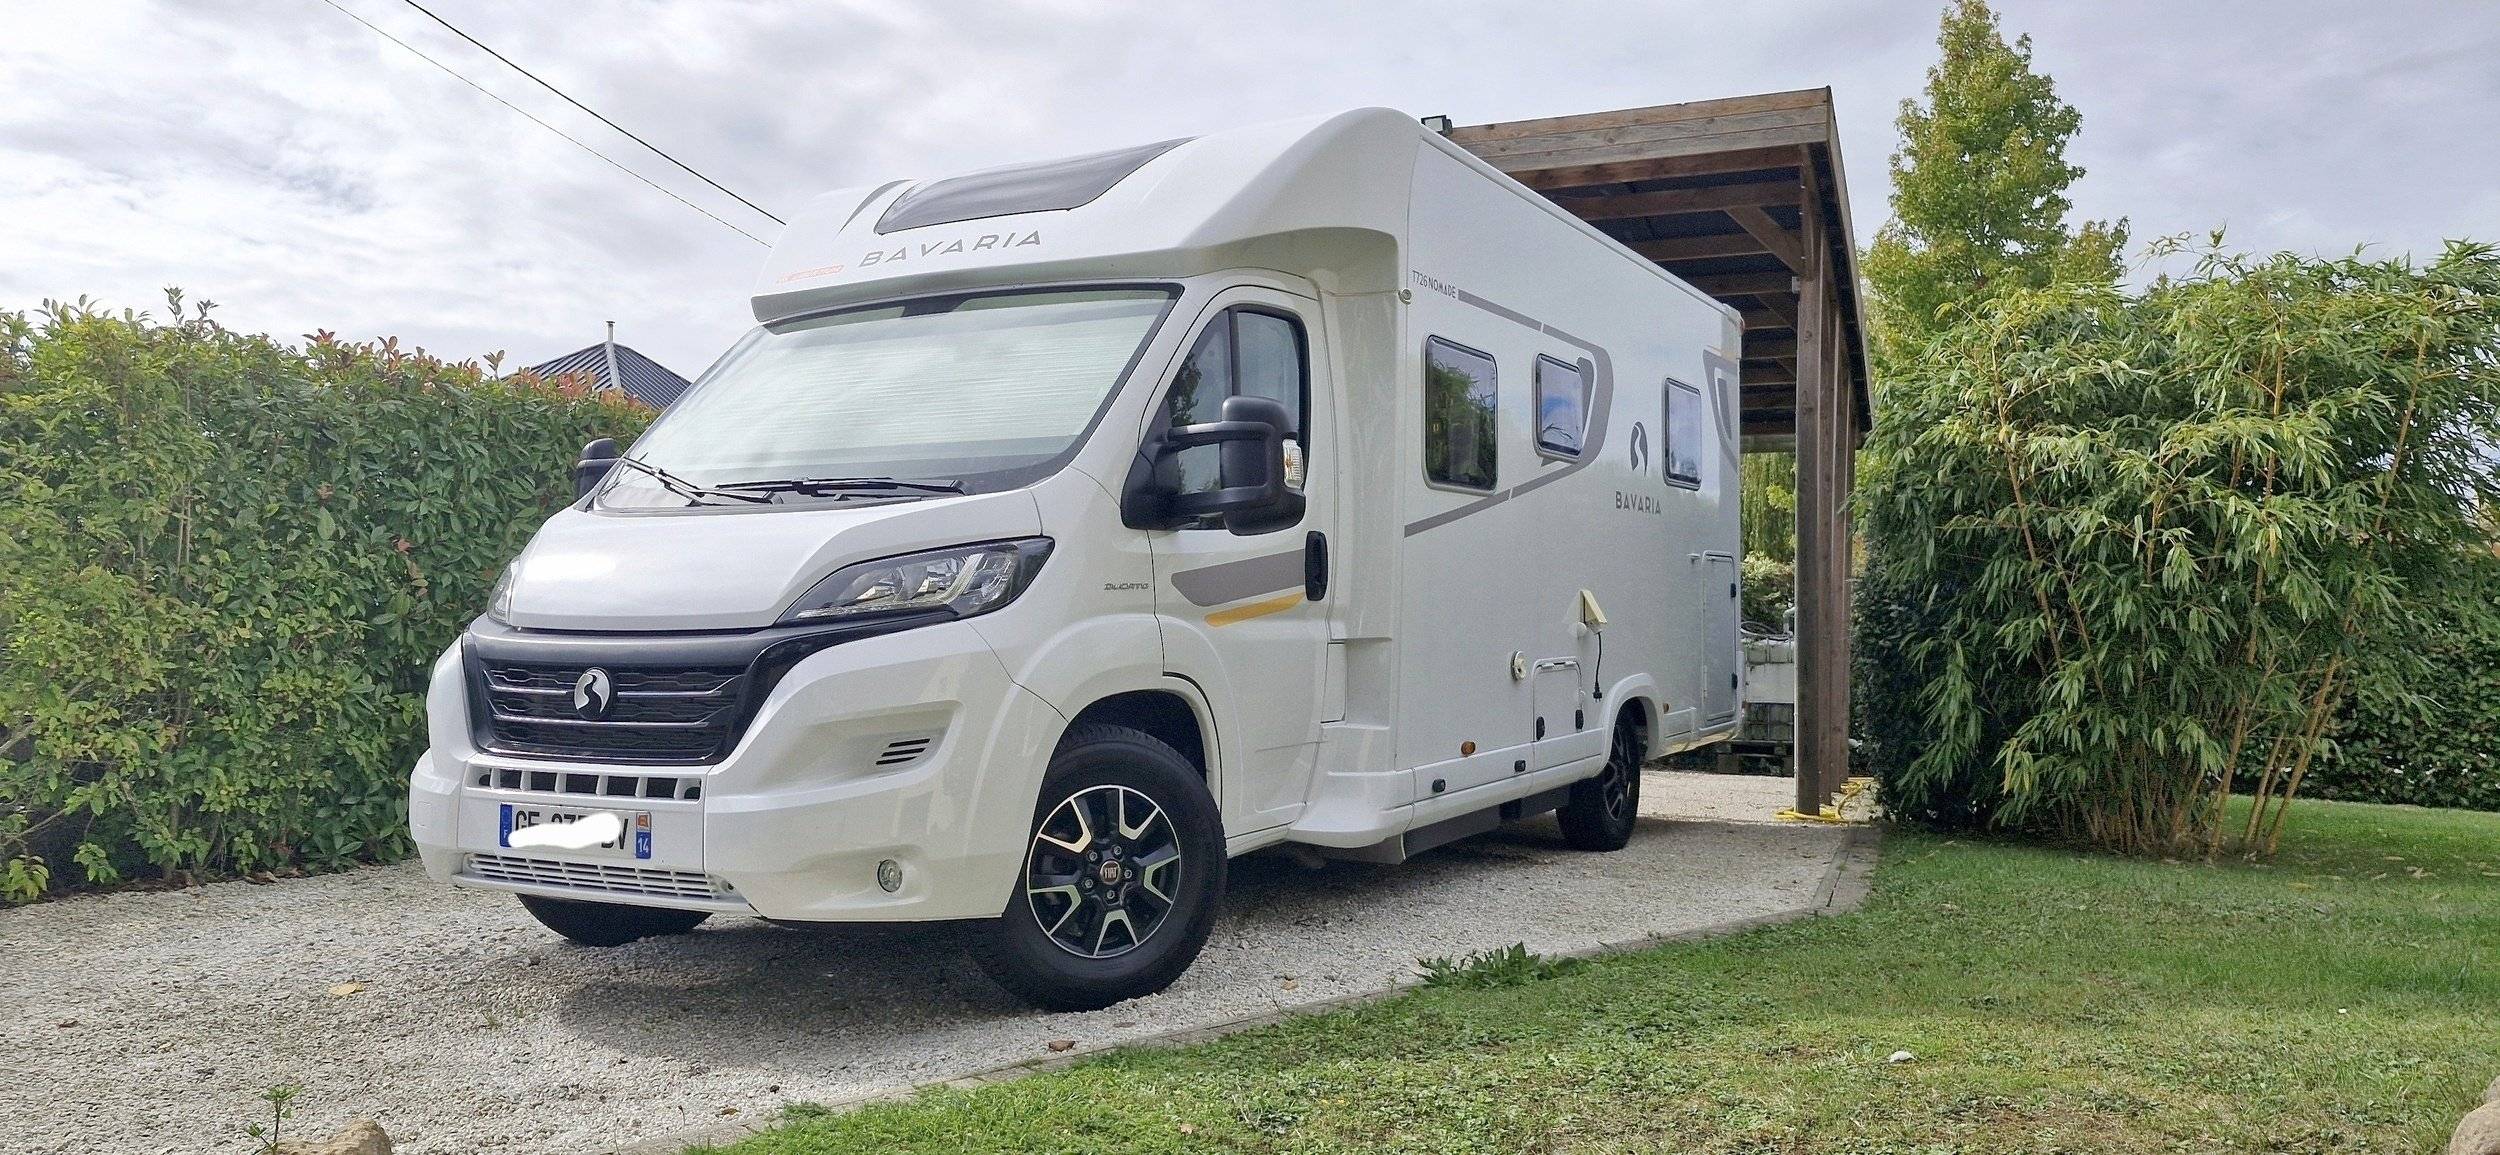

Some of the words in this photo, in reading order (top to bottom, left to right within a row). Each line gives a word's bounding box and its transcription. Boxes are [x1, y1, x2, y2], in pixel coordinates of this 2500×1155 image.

[858, 230, 1041, 267] BAVARIA
[1615, 490, 1661, 514] BAVARIA
[1104, 582, 1149, 591] DUCATO
[637, 837, 649, 853] 14
